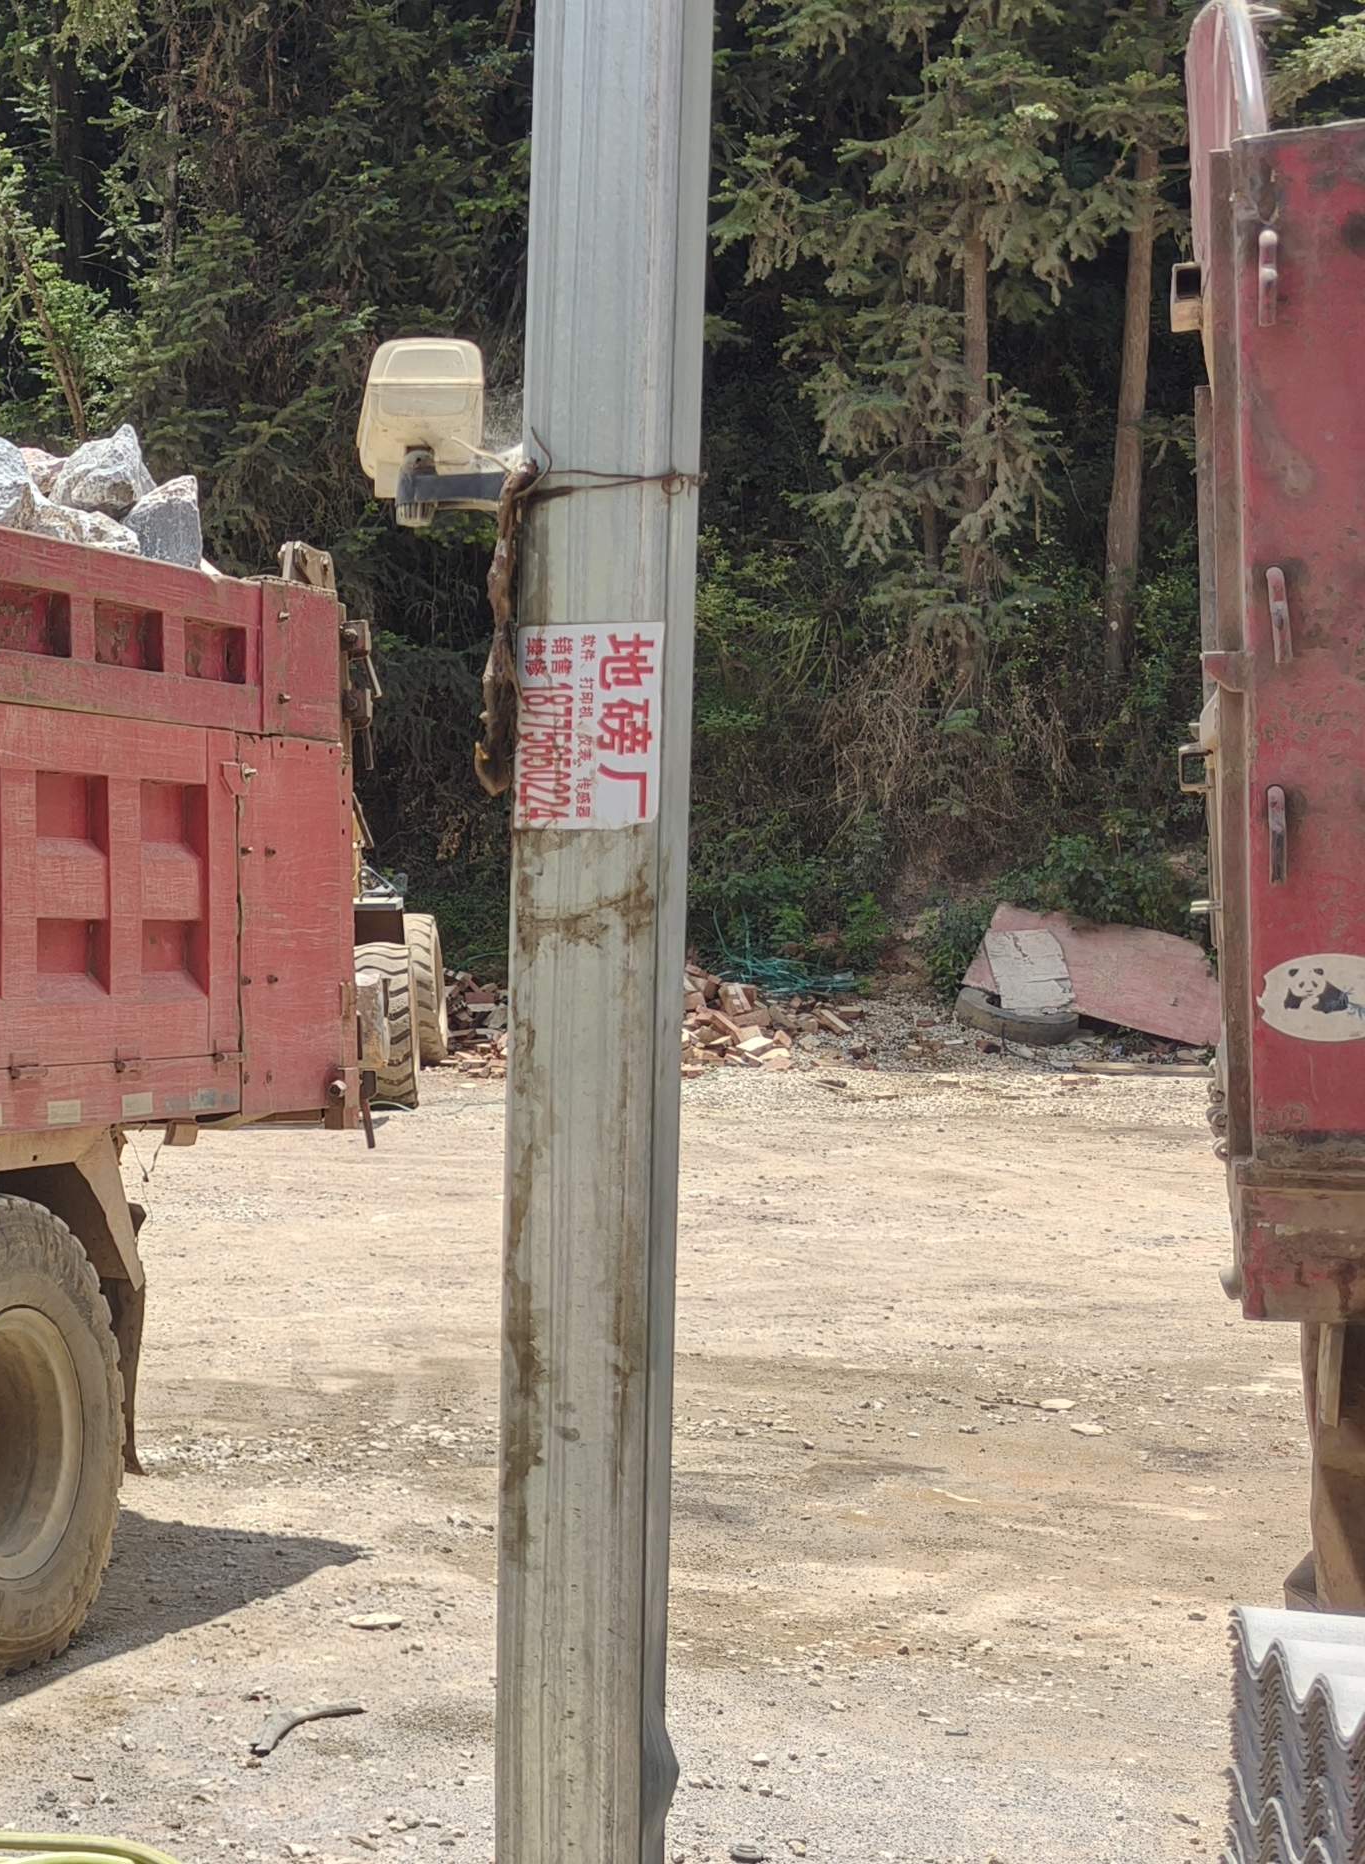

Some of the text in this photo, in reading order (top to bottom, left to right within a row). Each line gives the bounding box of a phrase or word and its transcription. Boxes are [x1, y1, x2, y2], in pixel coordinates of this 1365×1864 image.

[524, 635, 548, 677] 维修
[550, 635, 574, 677] 销售
[597, 632, 655, 819] 地磅厂
